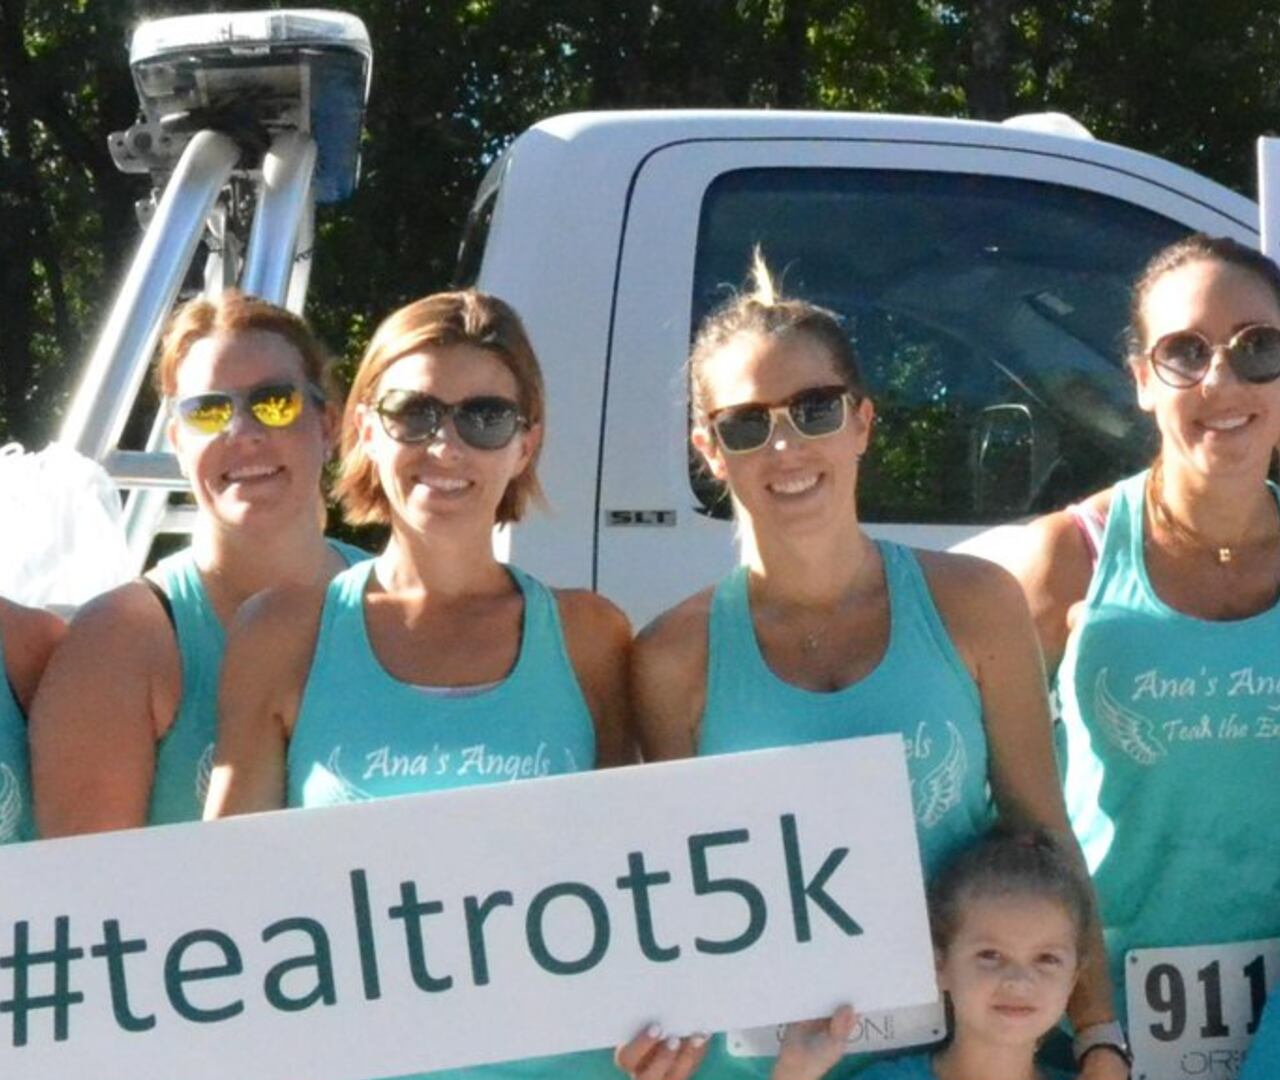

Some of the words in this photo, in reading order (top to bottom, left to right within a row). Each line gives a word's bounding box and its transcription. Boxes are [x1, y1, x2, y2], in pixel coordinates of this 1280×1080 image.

[609, 511, 672, 525] SLT
[1130, 665, 1219, 701] Ana's
[1218, 713, 1248, 738] the
[362, 743, 450, 780] Ana's
[1145, 955, 1267, 1042] 911
